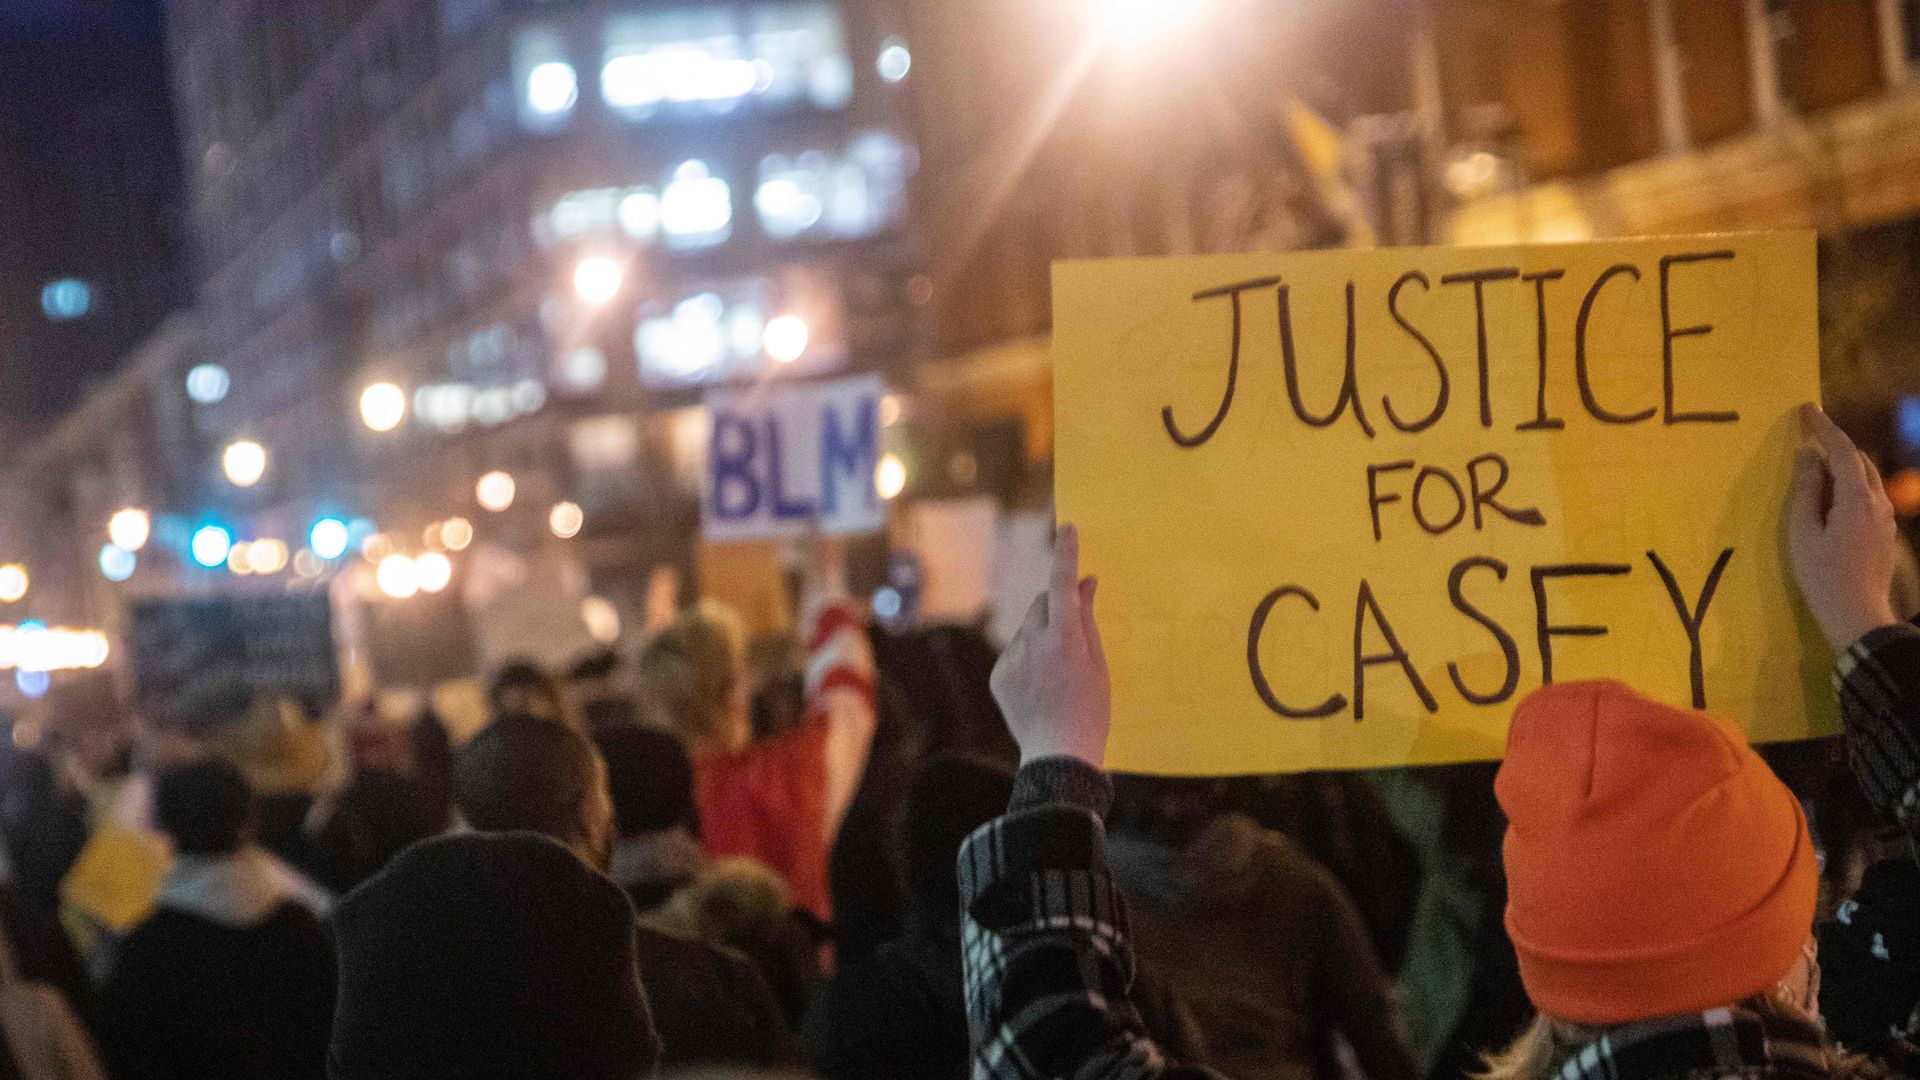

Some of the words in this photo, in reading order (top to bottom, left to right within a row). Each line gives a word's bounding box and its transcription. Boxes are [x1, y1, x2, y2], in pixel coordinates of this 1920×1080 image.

[1161, 250, 1739, 448] JUSTICE
[711, 394, 877, 520] BLM
[1366, 453, 1546, 541] FOR
[1246, 547, 1735, 722] CASEY
